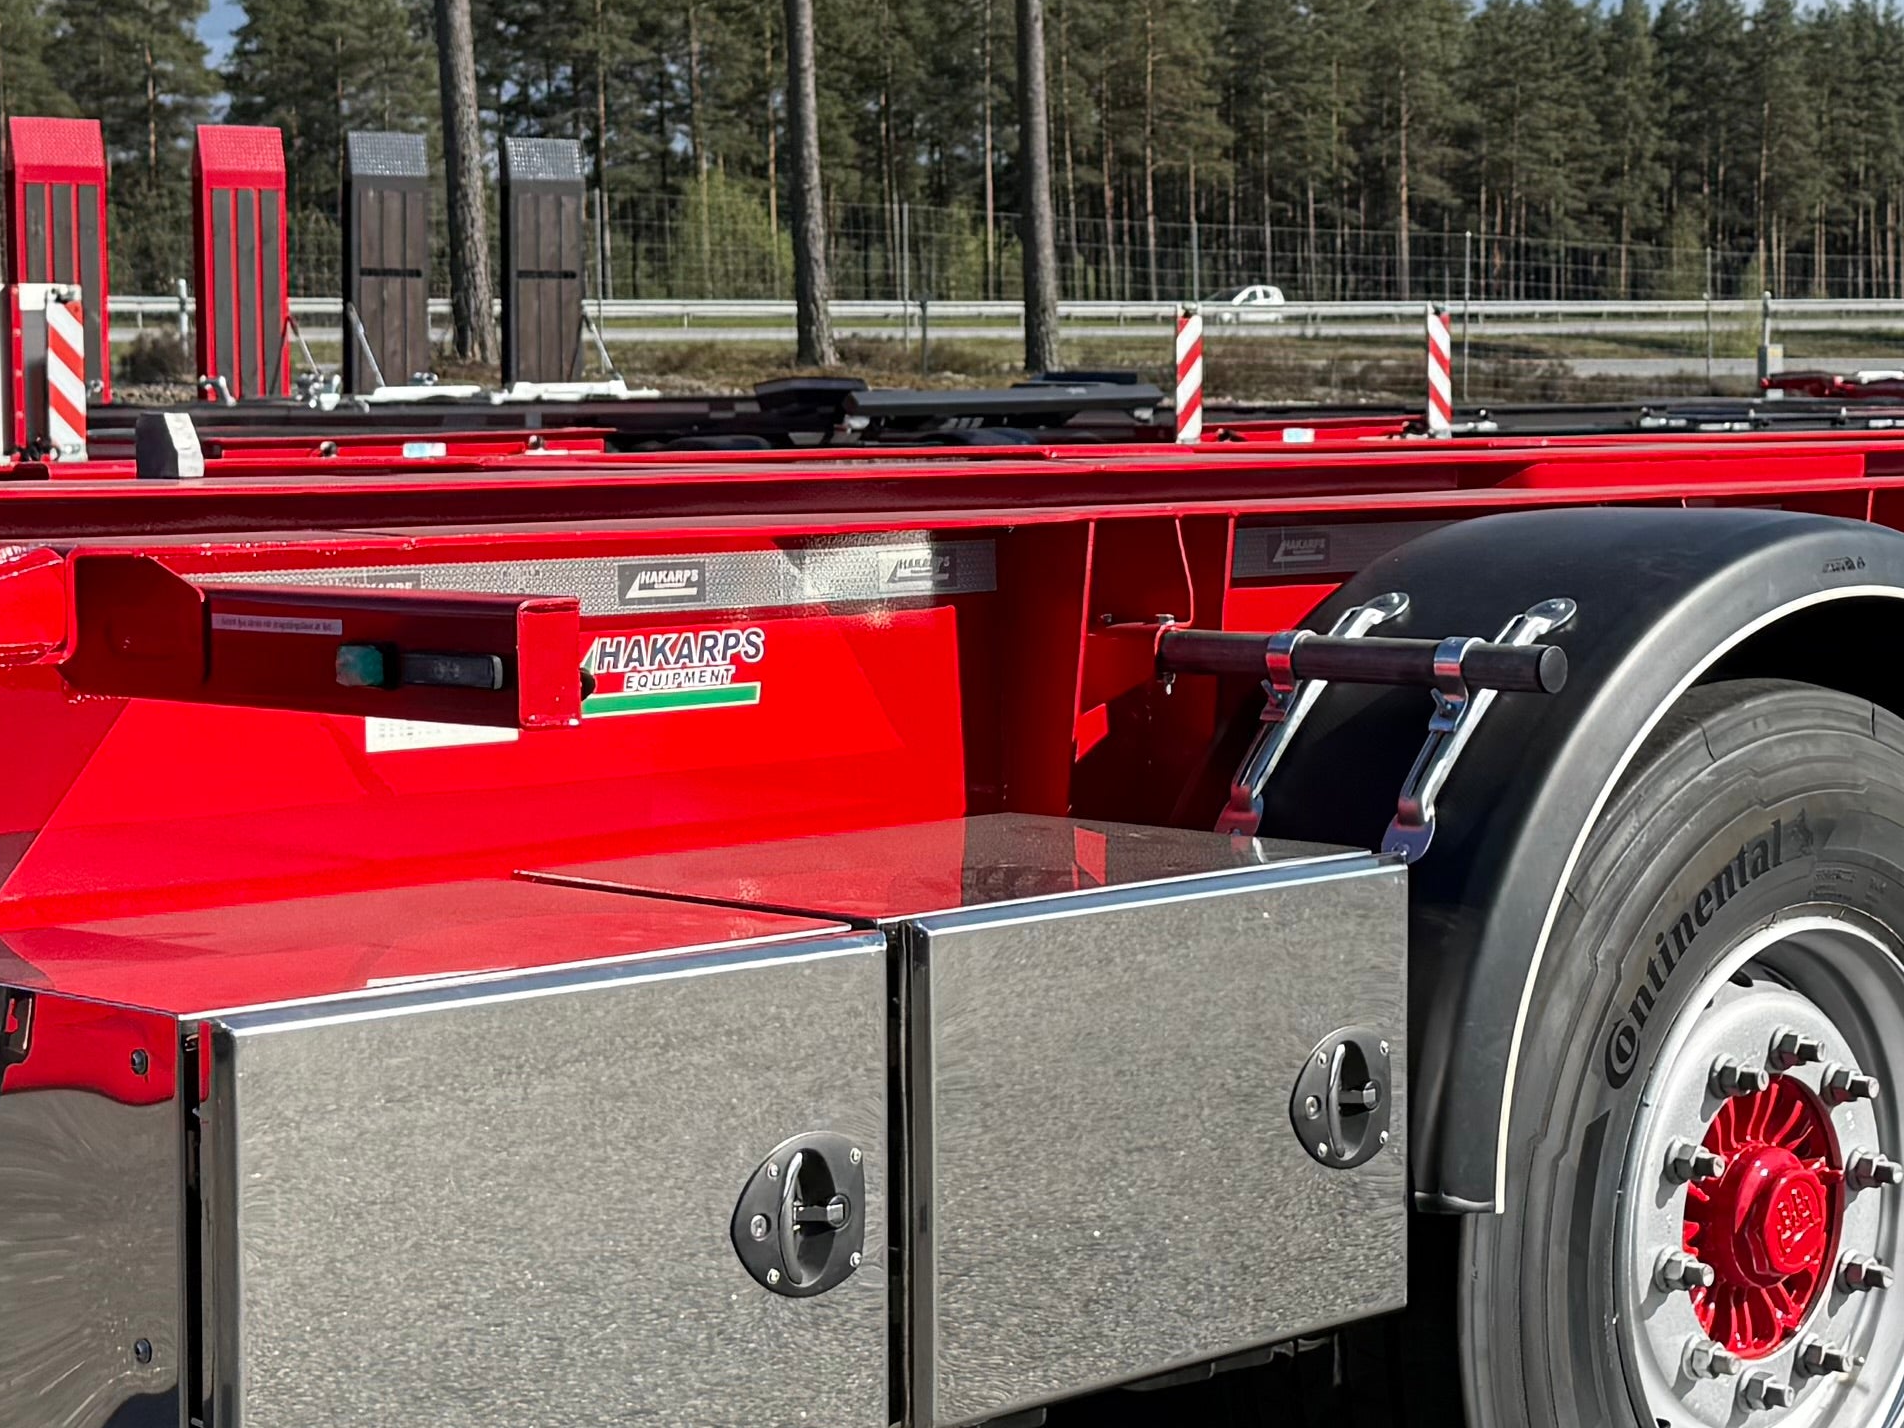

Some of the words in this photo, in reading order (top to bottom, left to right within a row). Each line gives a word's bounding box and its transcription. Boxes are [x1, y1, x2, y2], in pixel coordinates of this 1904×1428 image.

[640, 568, 699, 585] HAKARPS
[597, 629, 764, 670] HAKARPS
[625, 667, 734, 691] EQUIPMENT
[1605, 820, 1783, 1090] Continental
